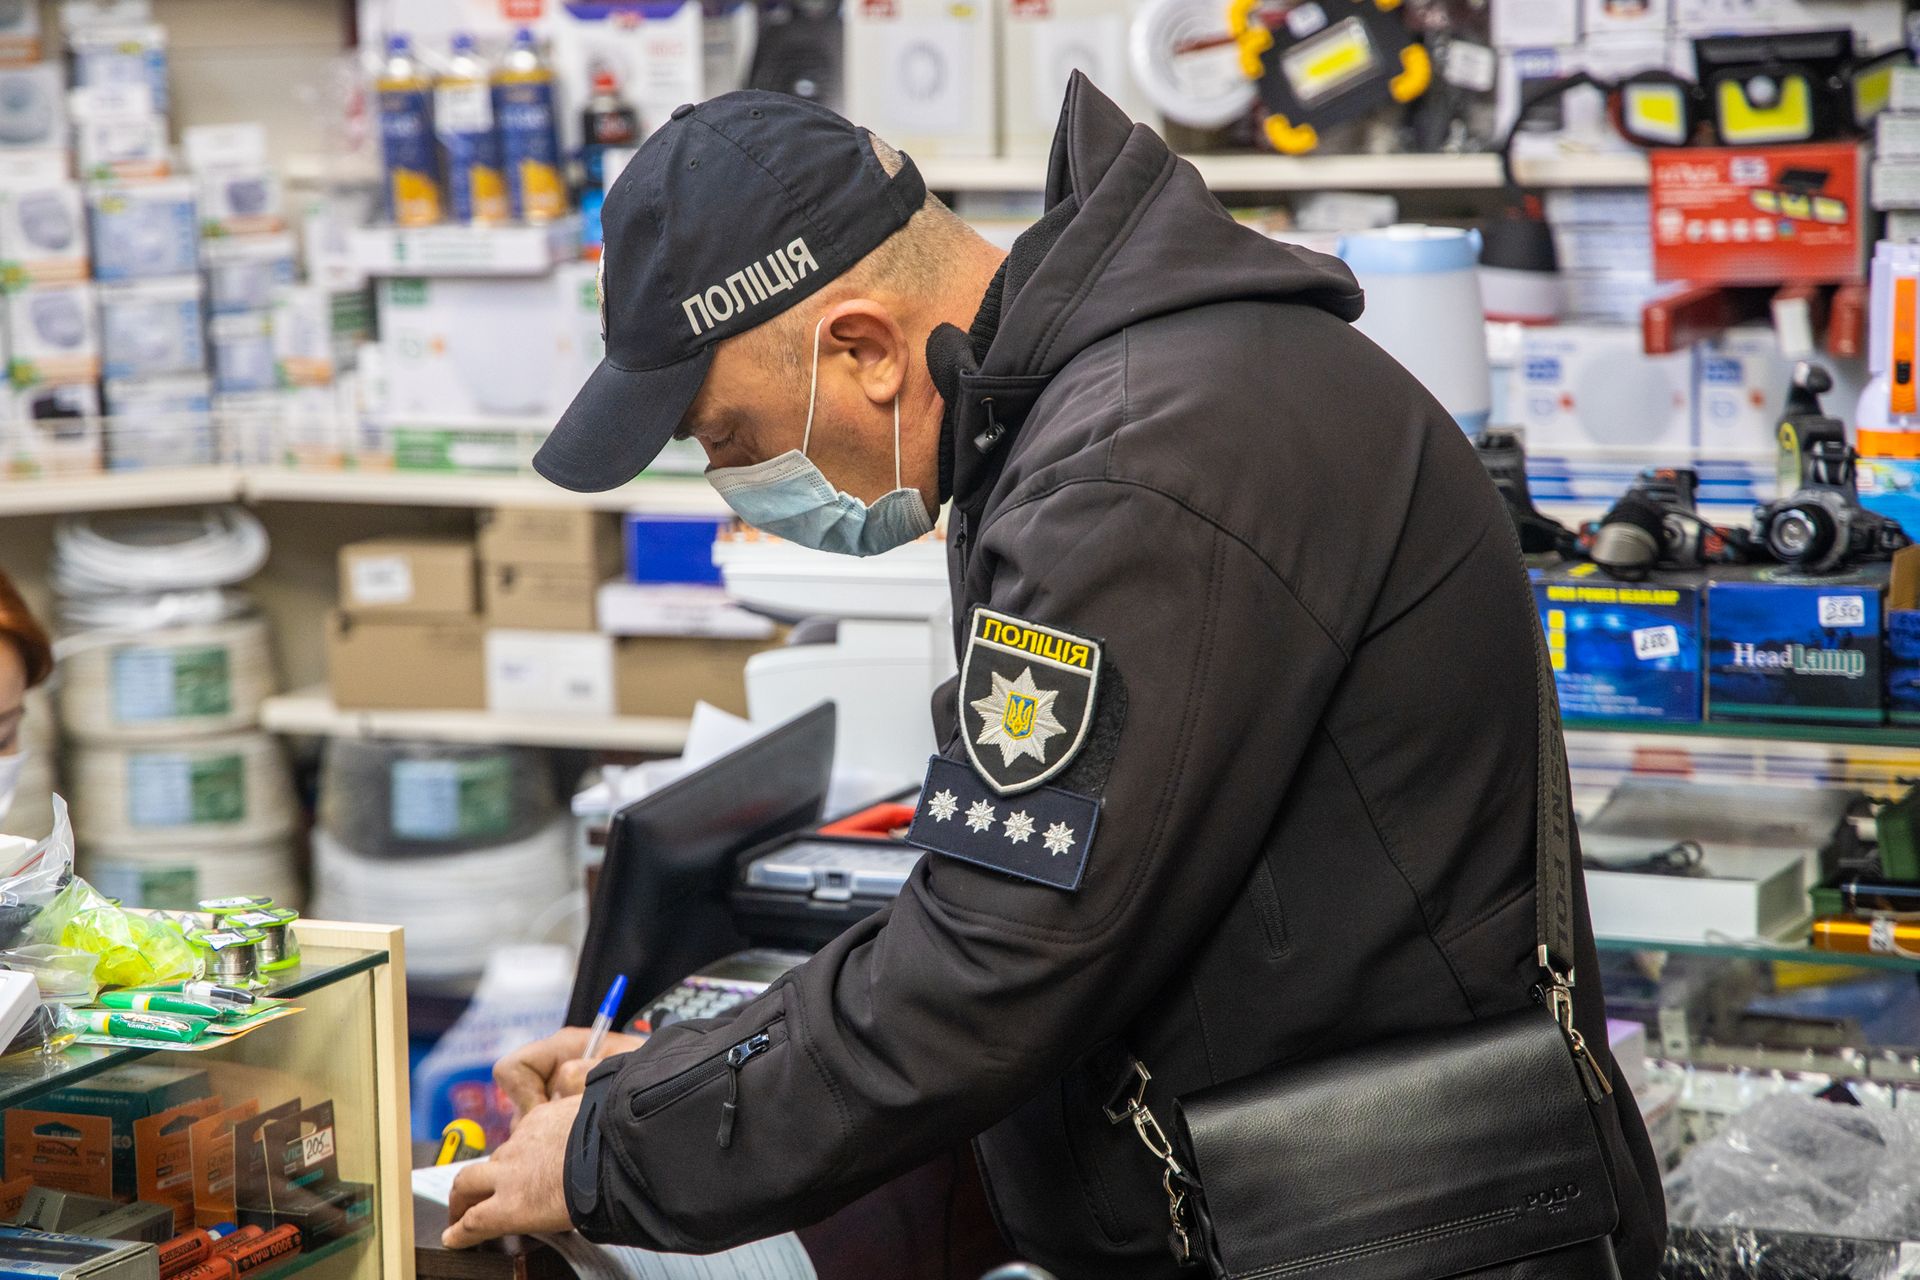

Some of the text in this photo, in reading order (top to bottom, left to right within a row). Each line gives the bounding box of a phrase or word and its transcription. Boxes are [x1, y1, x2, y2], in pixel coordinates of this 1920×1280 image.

[682, 236, 819, 335] ПОЛІЦІЯ
[1577, 586, 1617, 604] POWER
[1618, 588, 1680, 606] HEADLAMP
[982, 618, 1089, 668] ПОЛІЦІЯ
[1526, 1183, 1582, 1211] POLO
